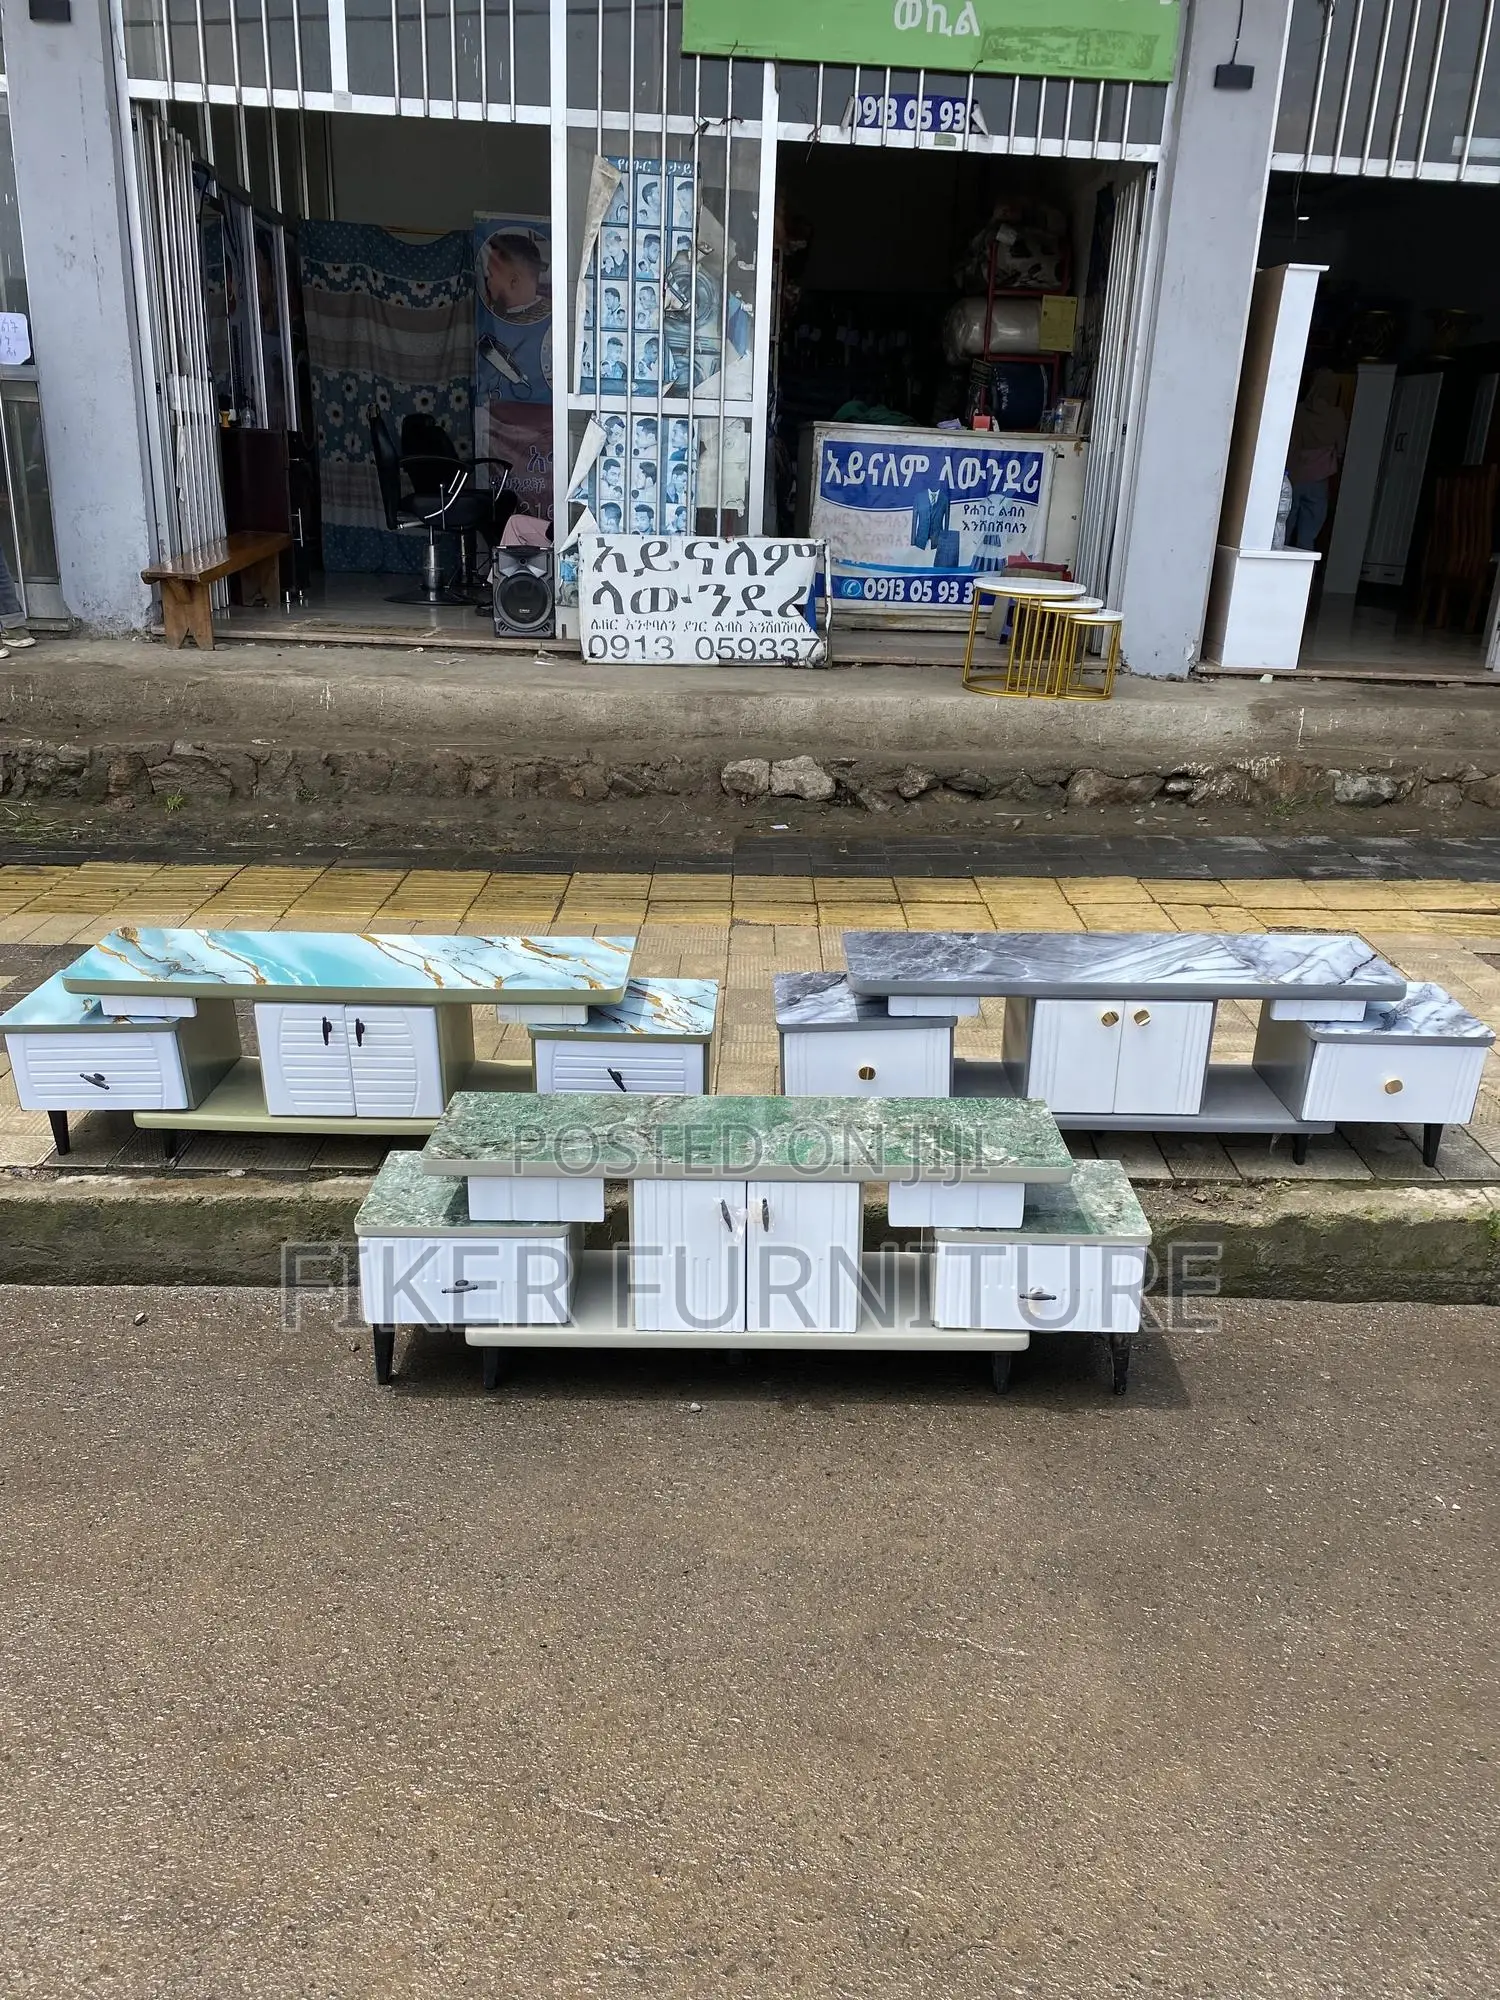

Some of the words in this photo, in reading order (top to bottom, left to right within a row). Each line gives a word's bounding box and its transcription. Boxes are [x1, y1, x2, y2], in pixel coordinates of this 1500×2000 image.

[904, 99, 933, 130] 05
[939, 101, 966, 132] 93
[825, 450, 930, 487] አይናለም
[939, 455, 1040, 494] ላውንደሪ
[998, 506, 1025, 517] ልብስ
[592, 536, 817, 577] አይናለም
[863, 578, 905, 601] 0913
[909, 580, 933, 602] 05
[938, 581, 959, 603] 93
[588, 634, 675, 660] 0913
[695, 636, 821, 662] 059337
